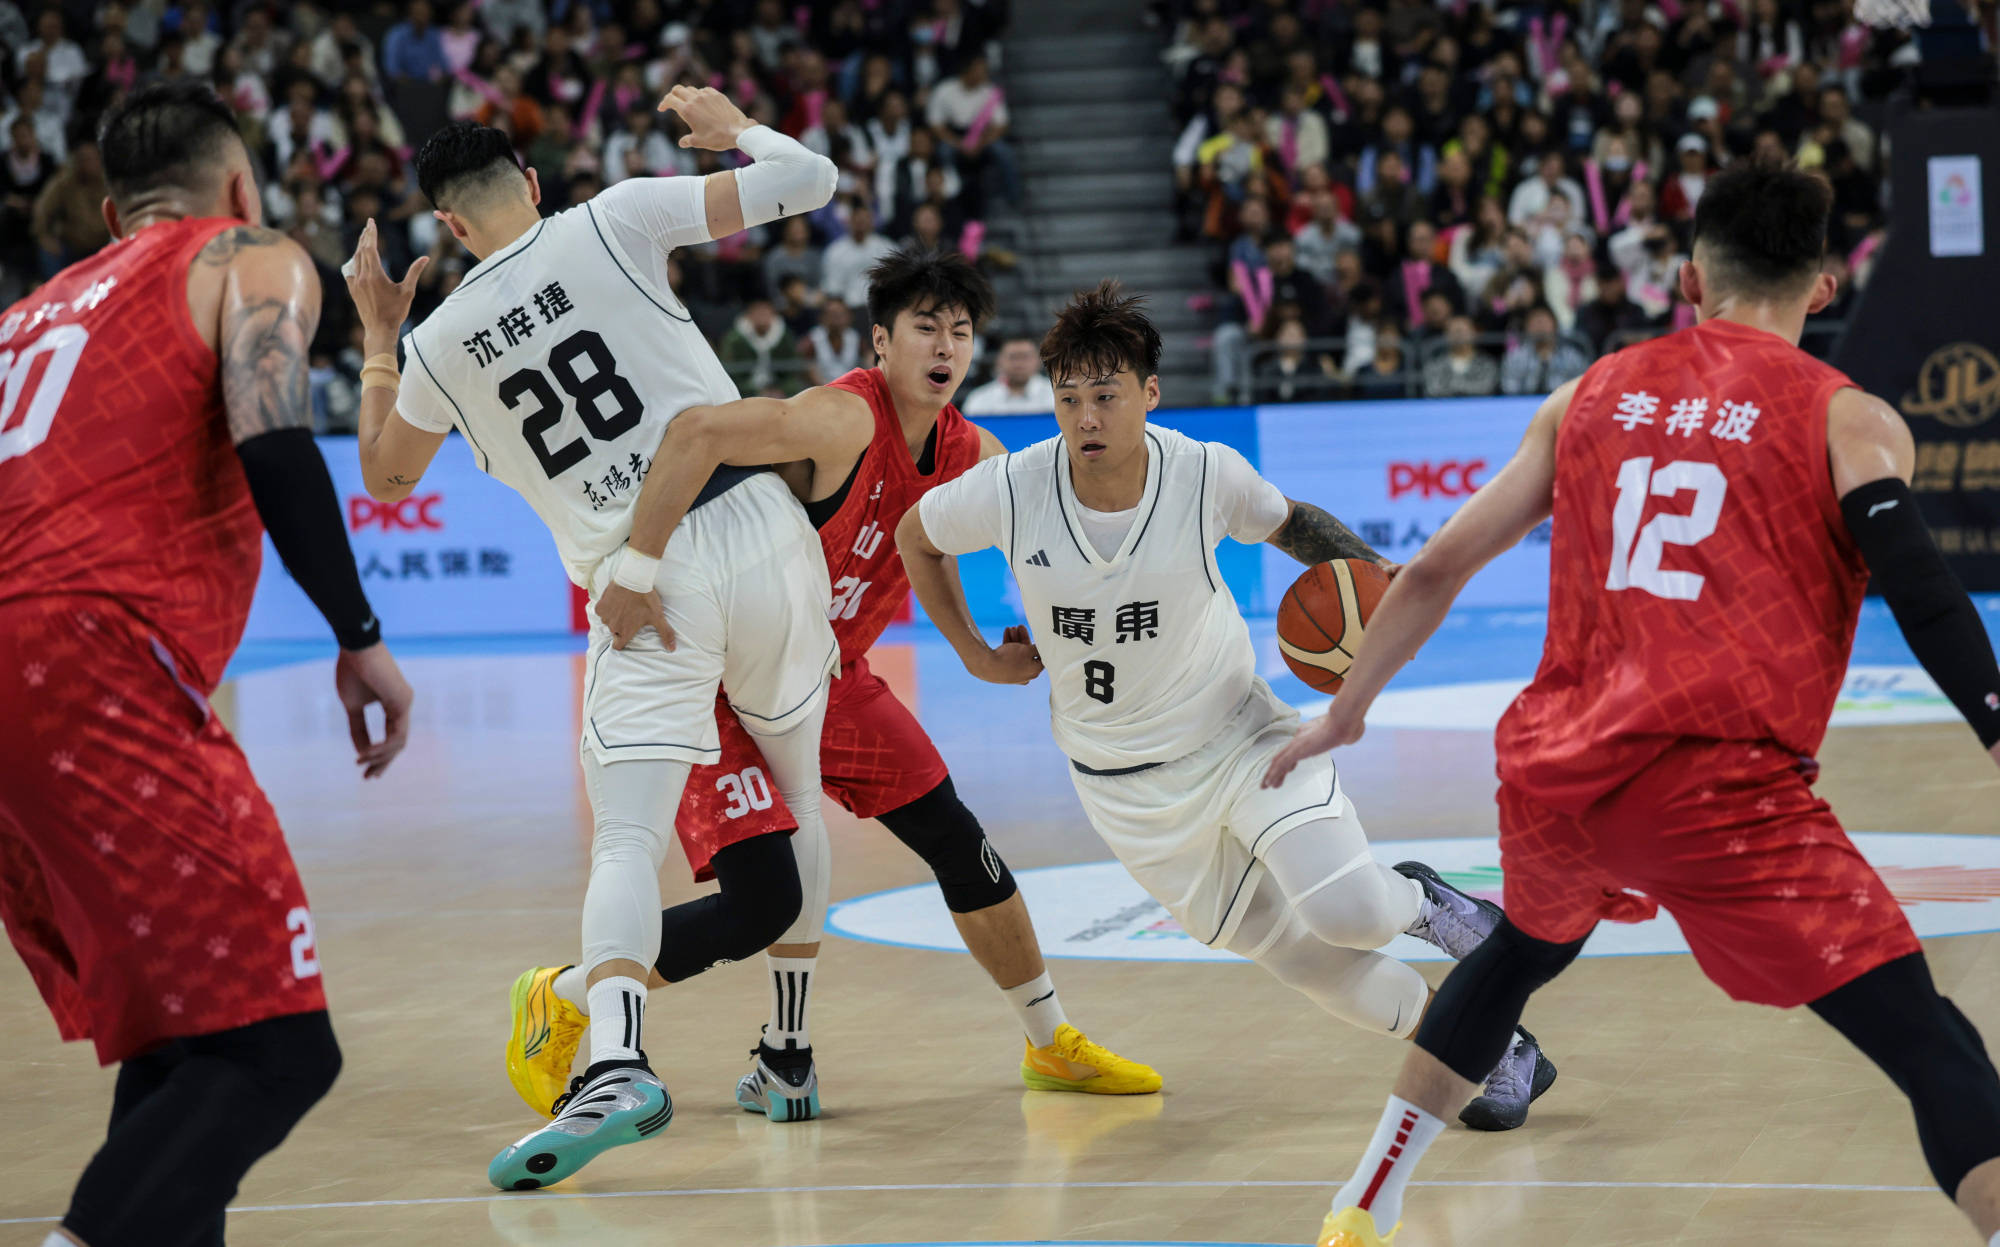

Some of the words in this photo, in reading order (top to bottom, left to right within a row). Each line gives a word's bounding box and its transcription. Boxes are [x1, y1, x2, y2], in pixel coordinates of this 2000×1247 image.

[462, 281, 574, 368] 沈梓捷
[499, 330, 644, 480] 28
[1612, 391, 1760, 444] 李祥波
[1388, 459, 1487, 500] PICC
[348, 493, 444, 535] PICC
[1604, 455, 1728, 601] 12
[1052, 600, 1159, 646] 廣東
[1084, 660, 1115, 704] 8
[715, 766, 773, 819] 30
